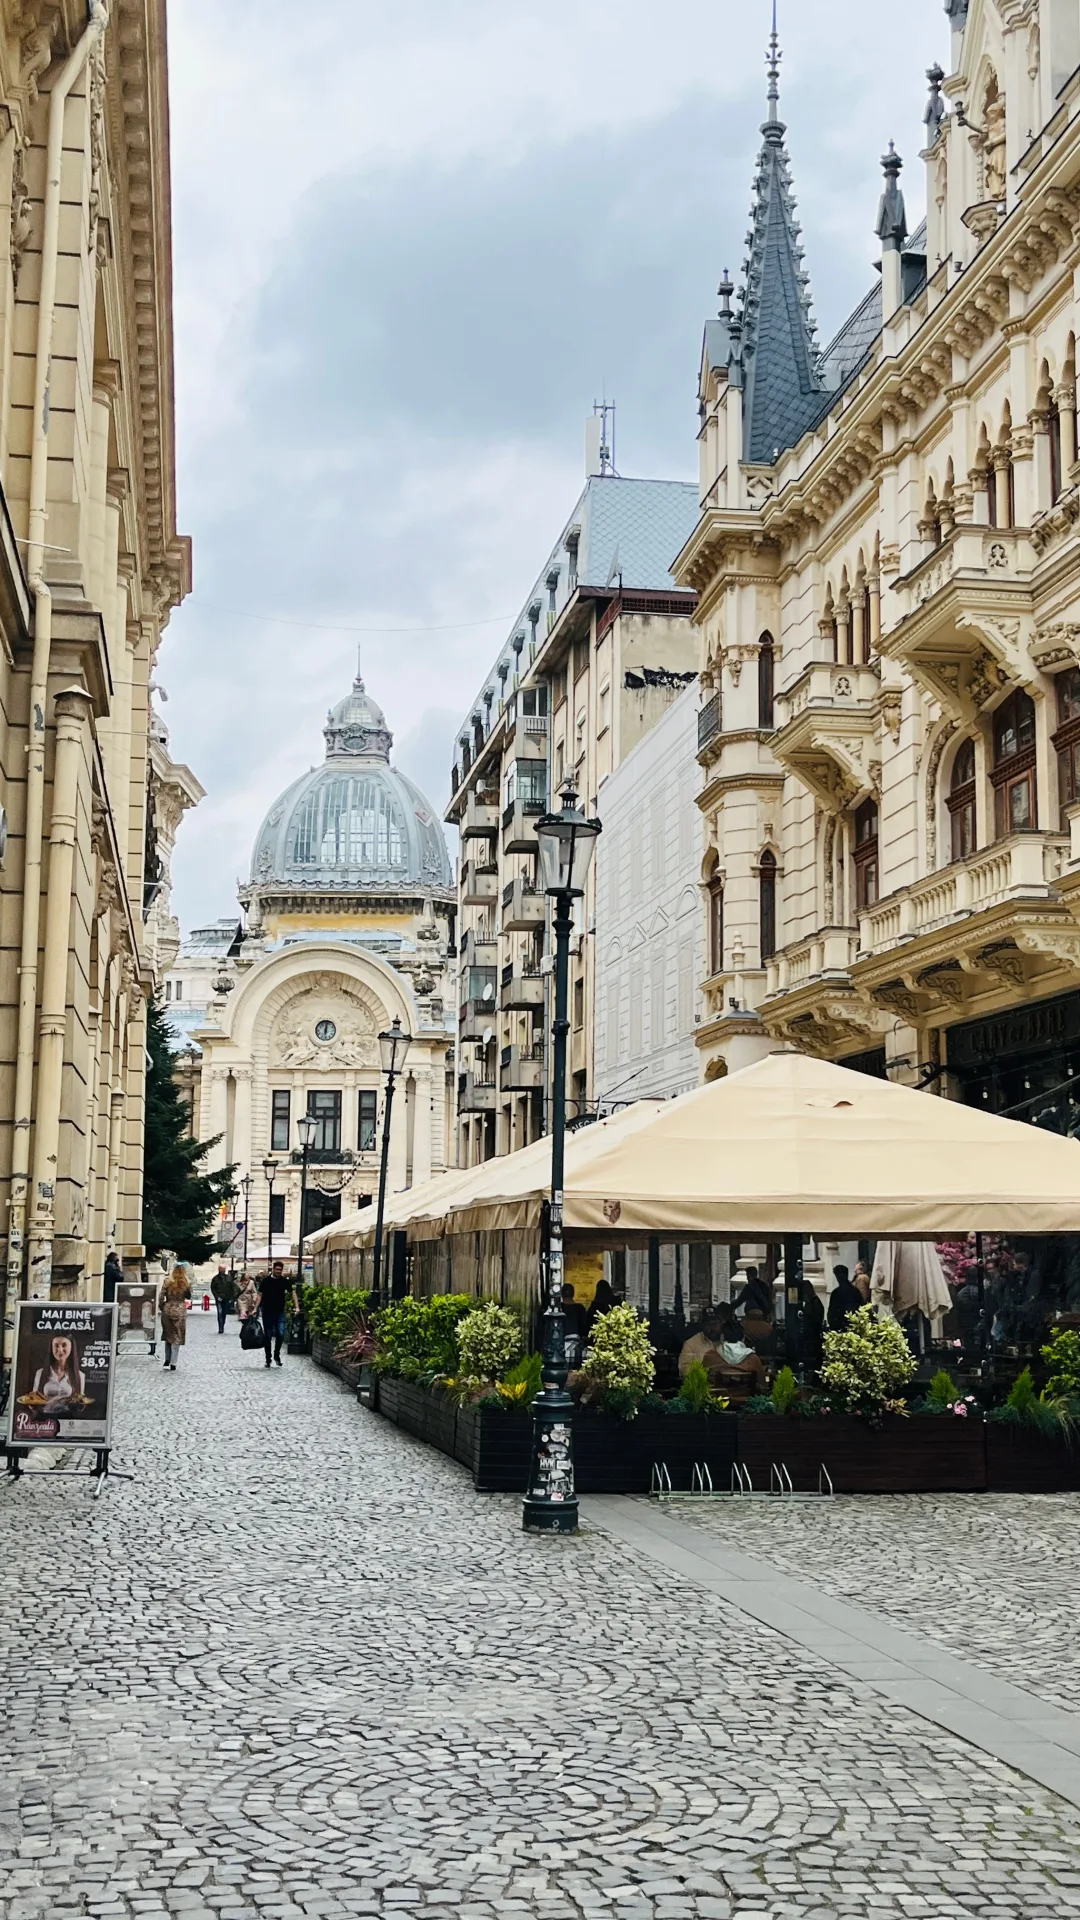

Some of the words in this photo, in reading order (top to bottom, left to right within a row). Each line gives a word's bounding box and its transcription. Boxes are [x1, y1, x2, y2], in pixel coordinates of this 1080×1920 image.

[42, 1310, 62, 1319] MAI
[65, 1310, 91, 1319] BINE
[37, 1321, 52, 1330] CA
[54, 1320, 95, 1331] ACASĂ!
